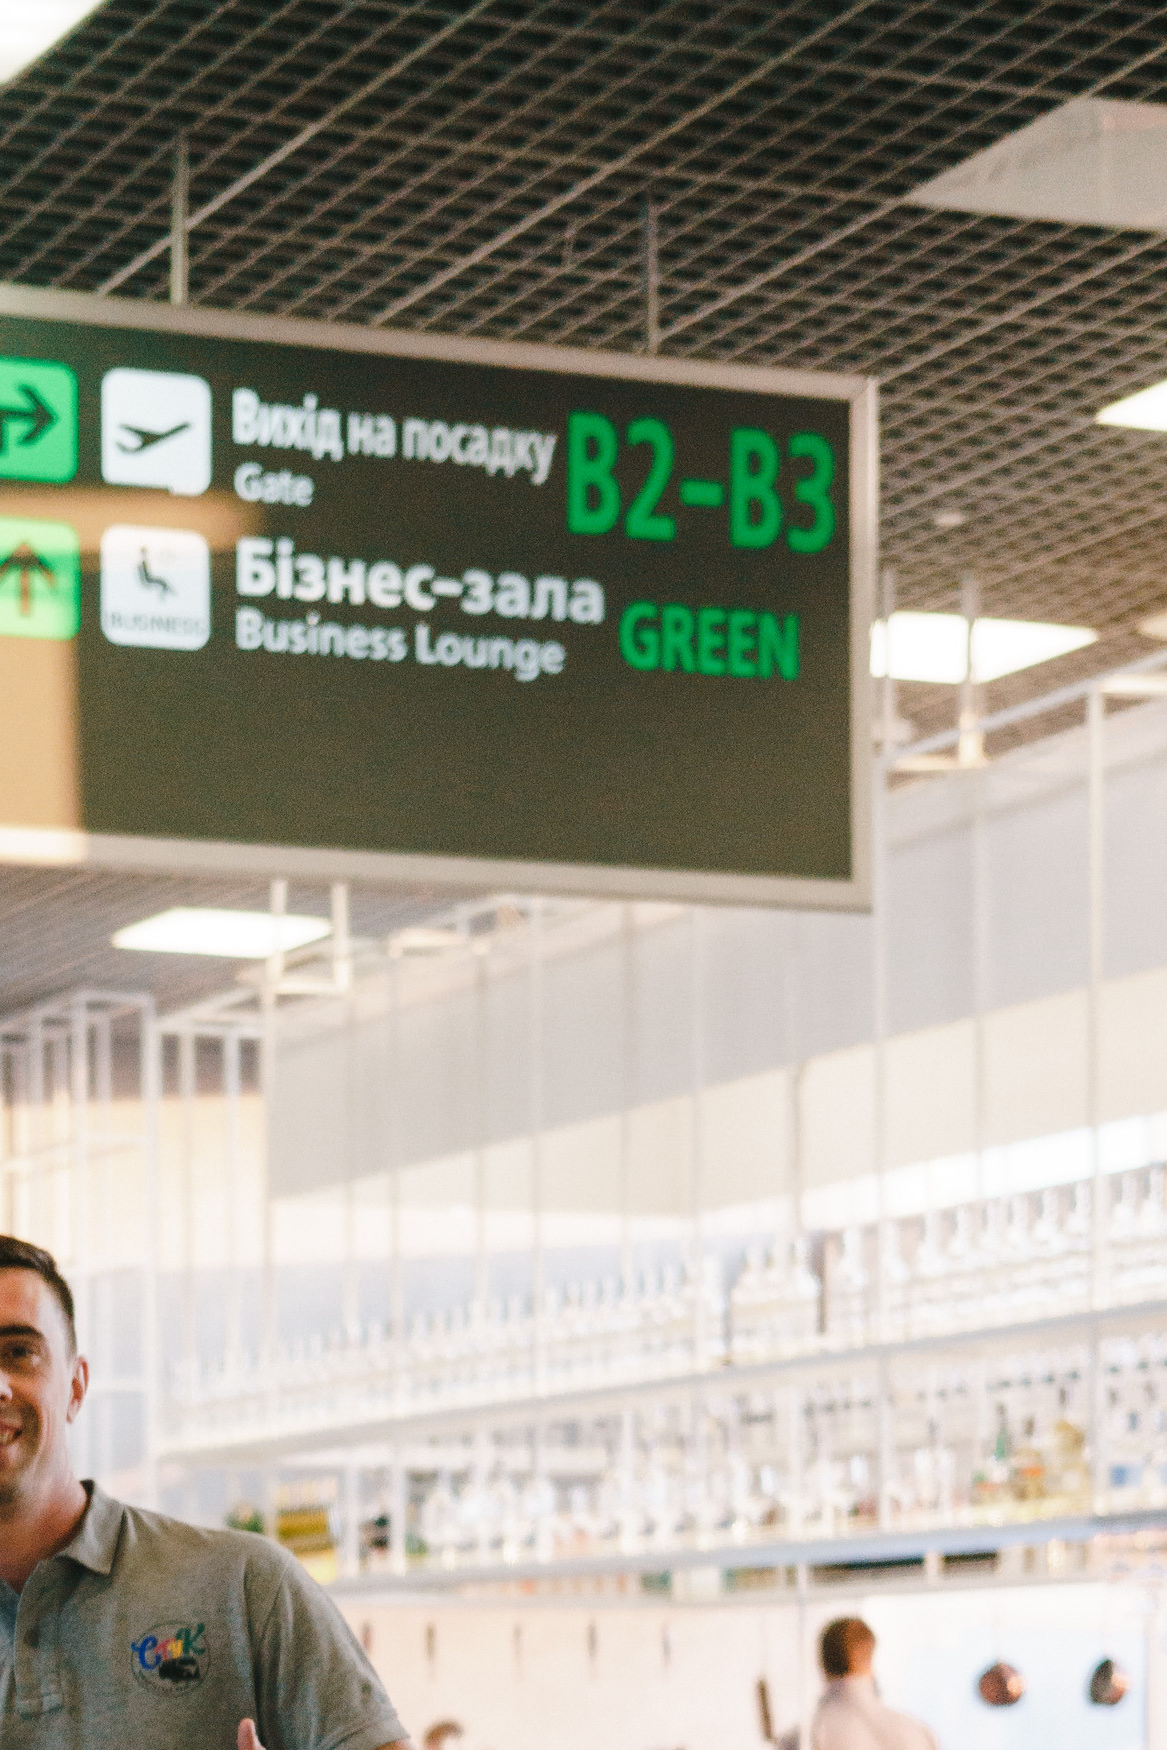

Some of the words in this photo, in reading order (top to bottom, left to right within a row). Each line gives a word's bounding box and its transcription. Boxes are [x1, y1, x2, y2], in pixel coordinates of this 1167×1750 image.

[231, 386, 344, 462] Вихід
[346, 411, 397, 459] на
[401, 416, 558, 486] посадку
[233, 461, 315, 507] Gate
[234, 535, 606, 625] Бізнес-зала
[234, 604, 408, 663] Business
[412, 619, 567, 682] Lounge
[617, 600, 801, 681] GREEN
